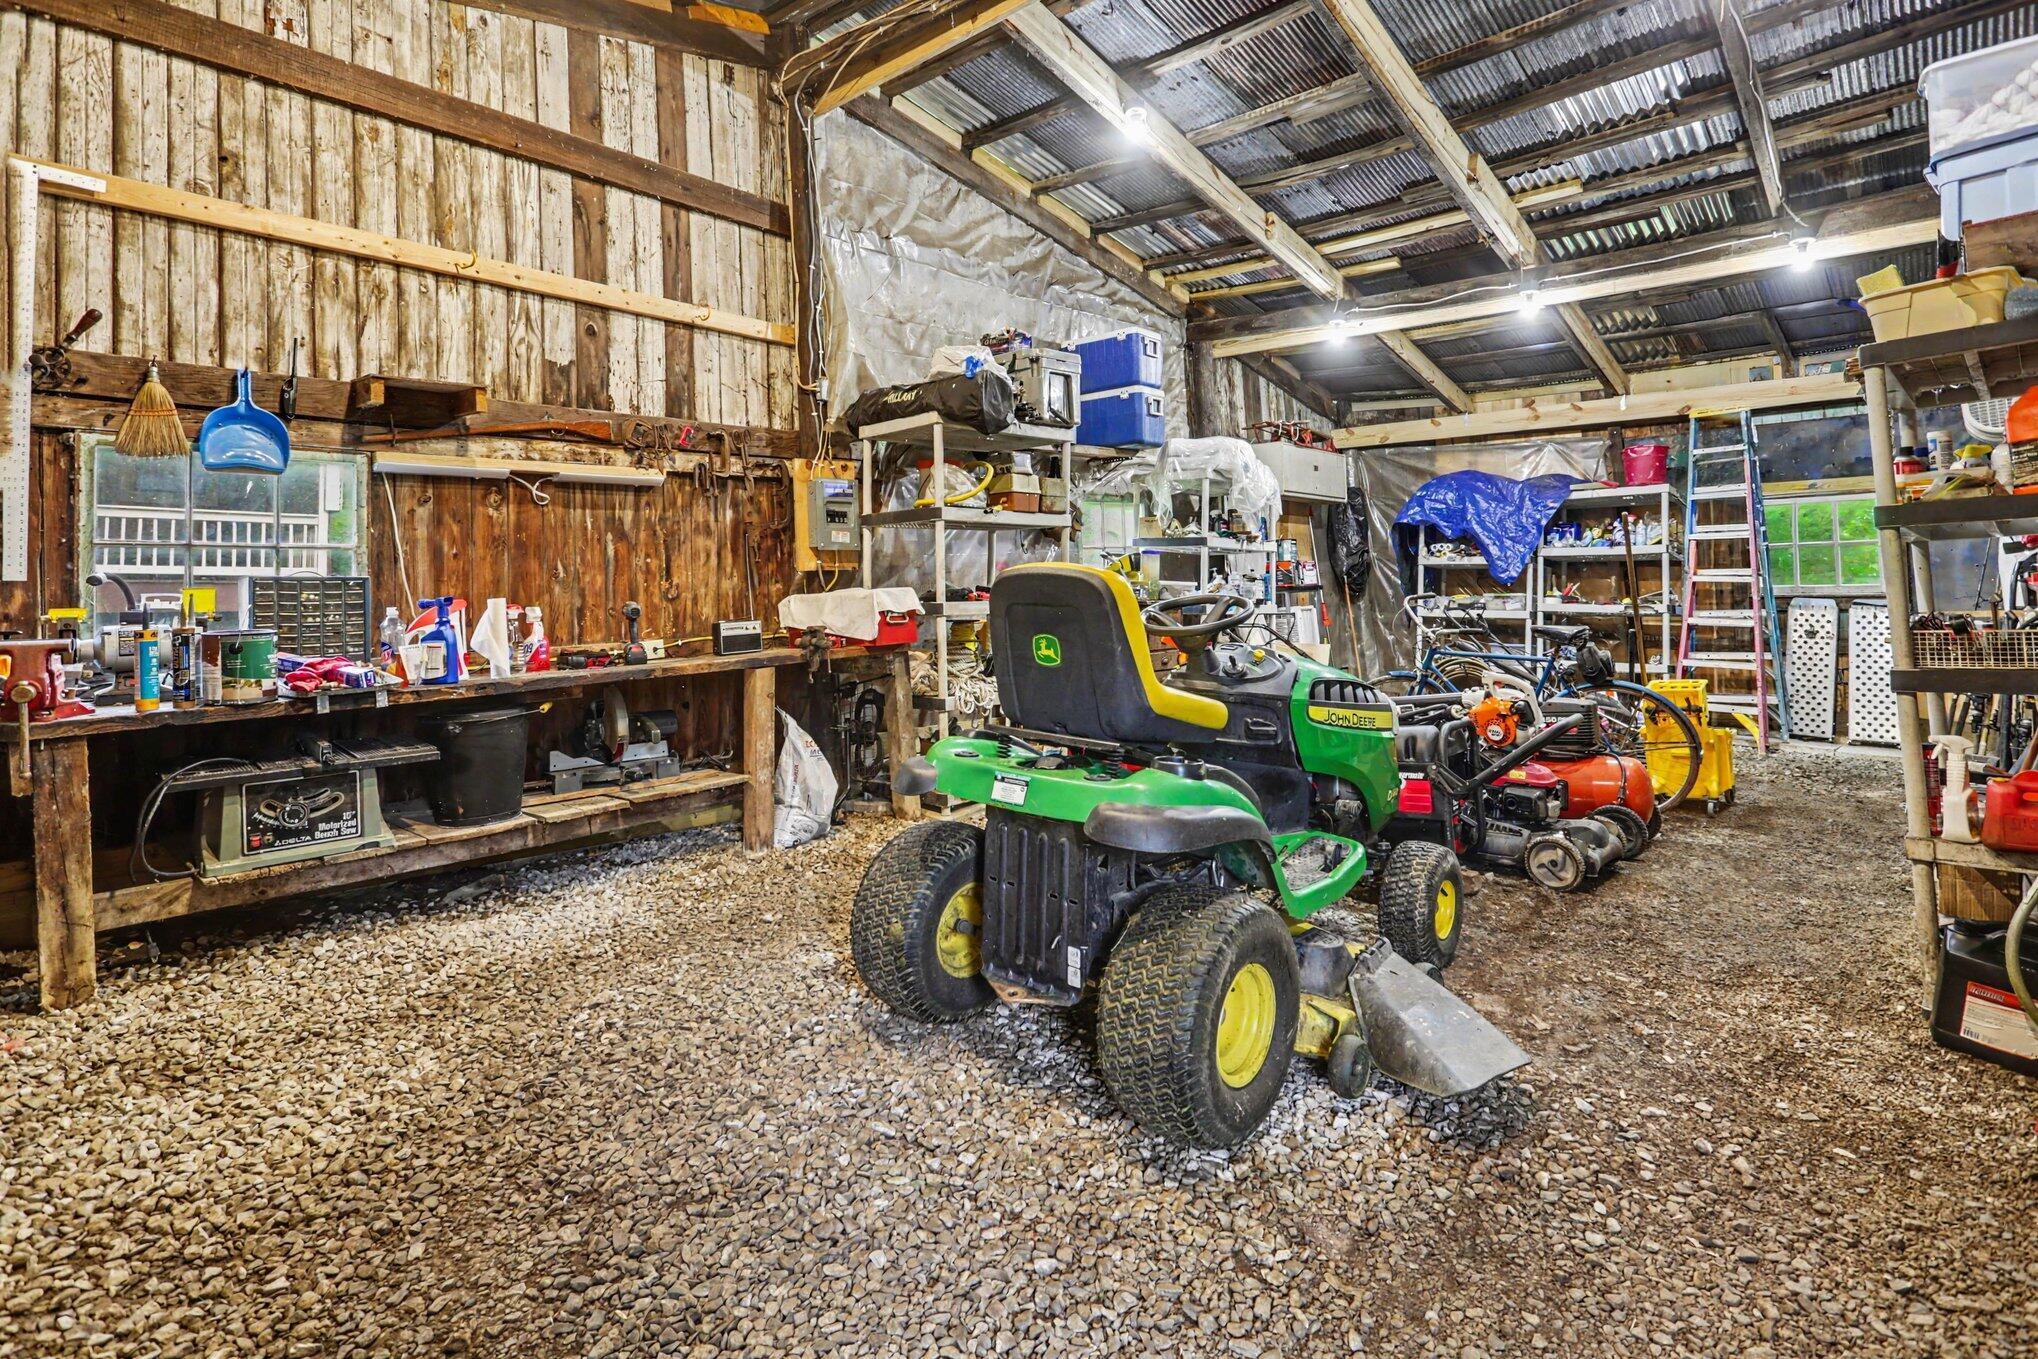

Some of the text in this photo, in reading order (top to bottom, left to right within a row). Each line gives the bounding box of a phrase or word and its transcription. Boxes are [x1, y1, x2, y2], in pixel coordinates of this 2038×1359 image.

[1324, 709, 1376, 727] JOHN DEERE
[318, 818, 357, 831] Motorized
[341, 827, 357, 836] Saw
